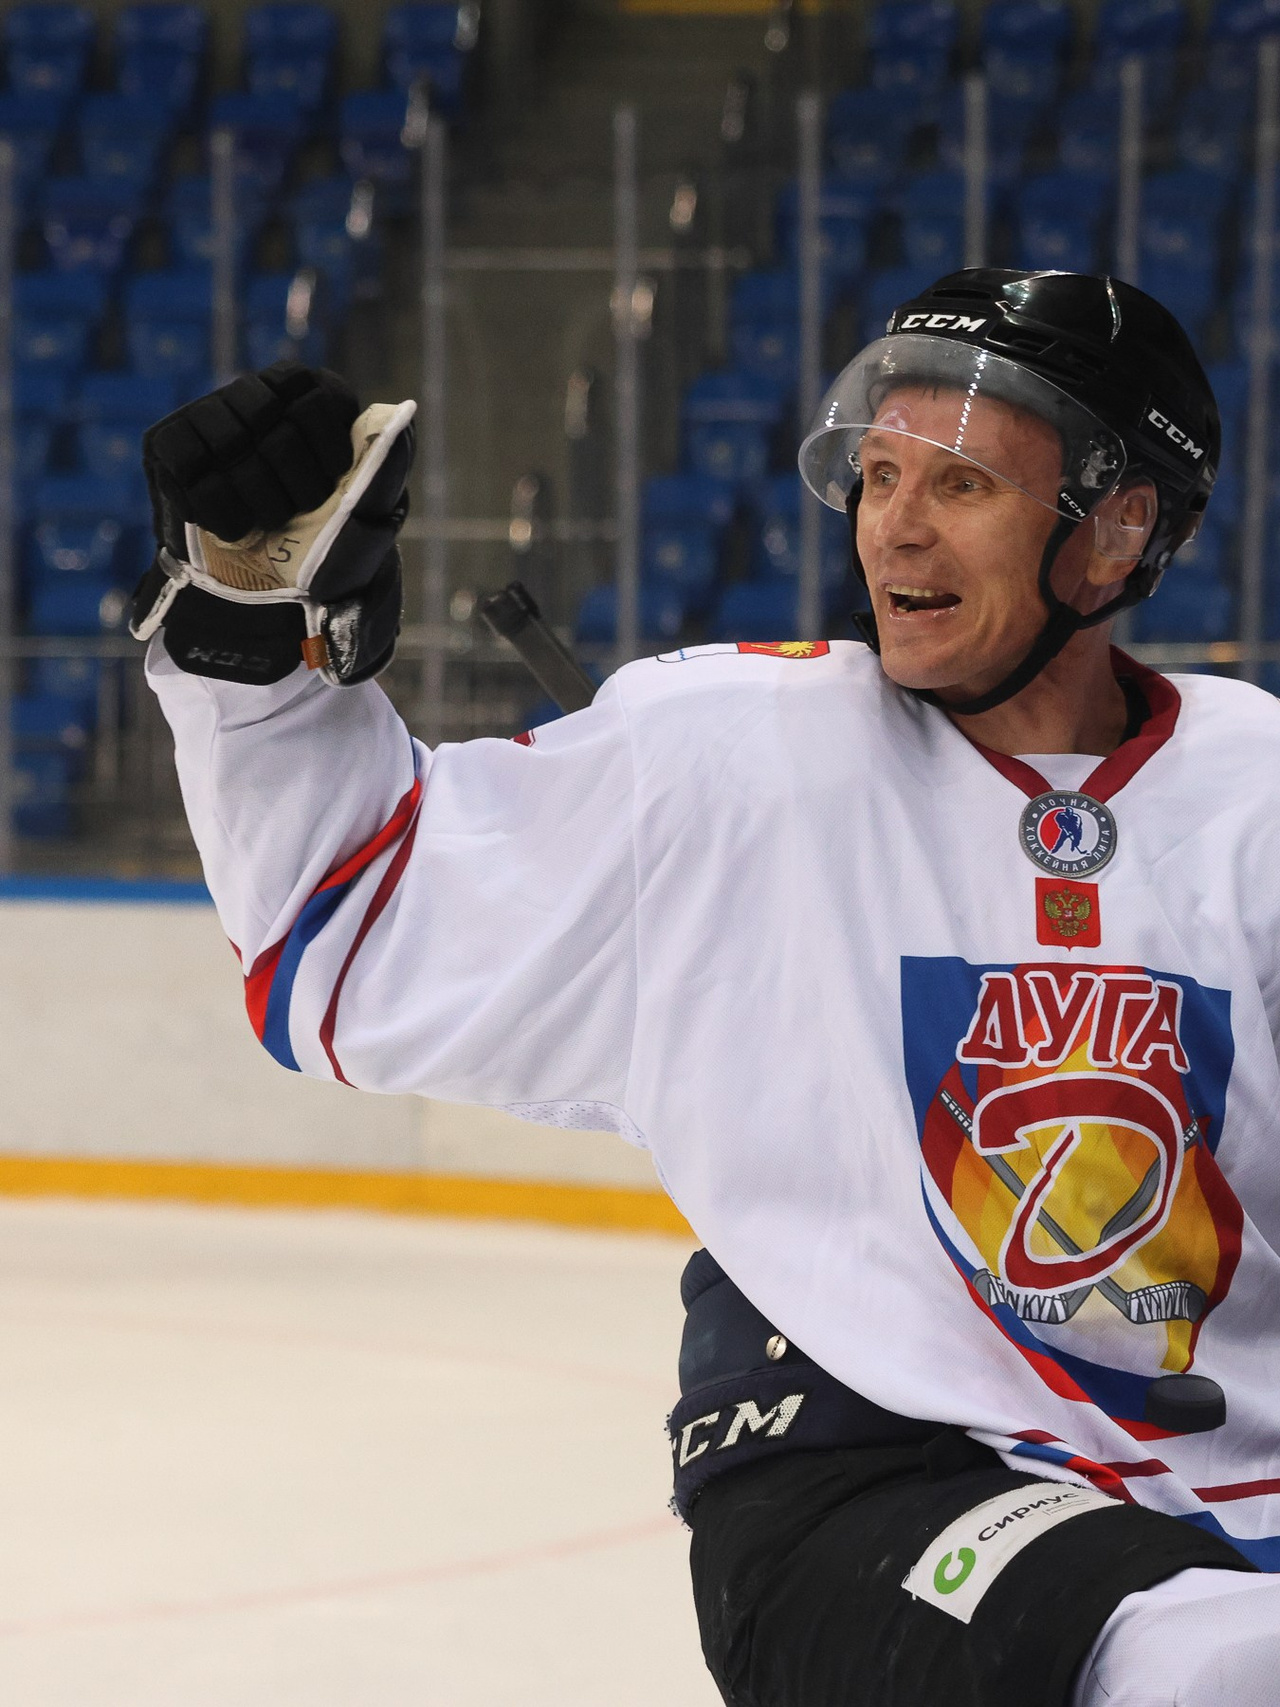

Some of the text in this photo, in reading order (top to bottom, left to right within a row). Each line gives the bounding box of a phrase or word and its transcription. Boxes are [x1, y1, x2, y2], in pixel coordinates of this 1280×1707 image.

[901, 314, 987, 333] CCM
[1147, 408, 1204, 460] CCM
[1060, 492, 1086, 518] CCM
[1038, 798, 1098, 813] НОЧНАЯ
[1026, 826, 1110, 872] ХОККЕЙНАЯ ЛИГА
[956, 971, 1190, 1074] ДУГА
[672, 1393, 805, 1467] CM
